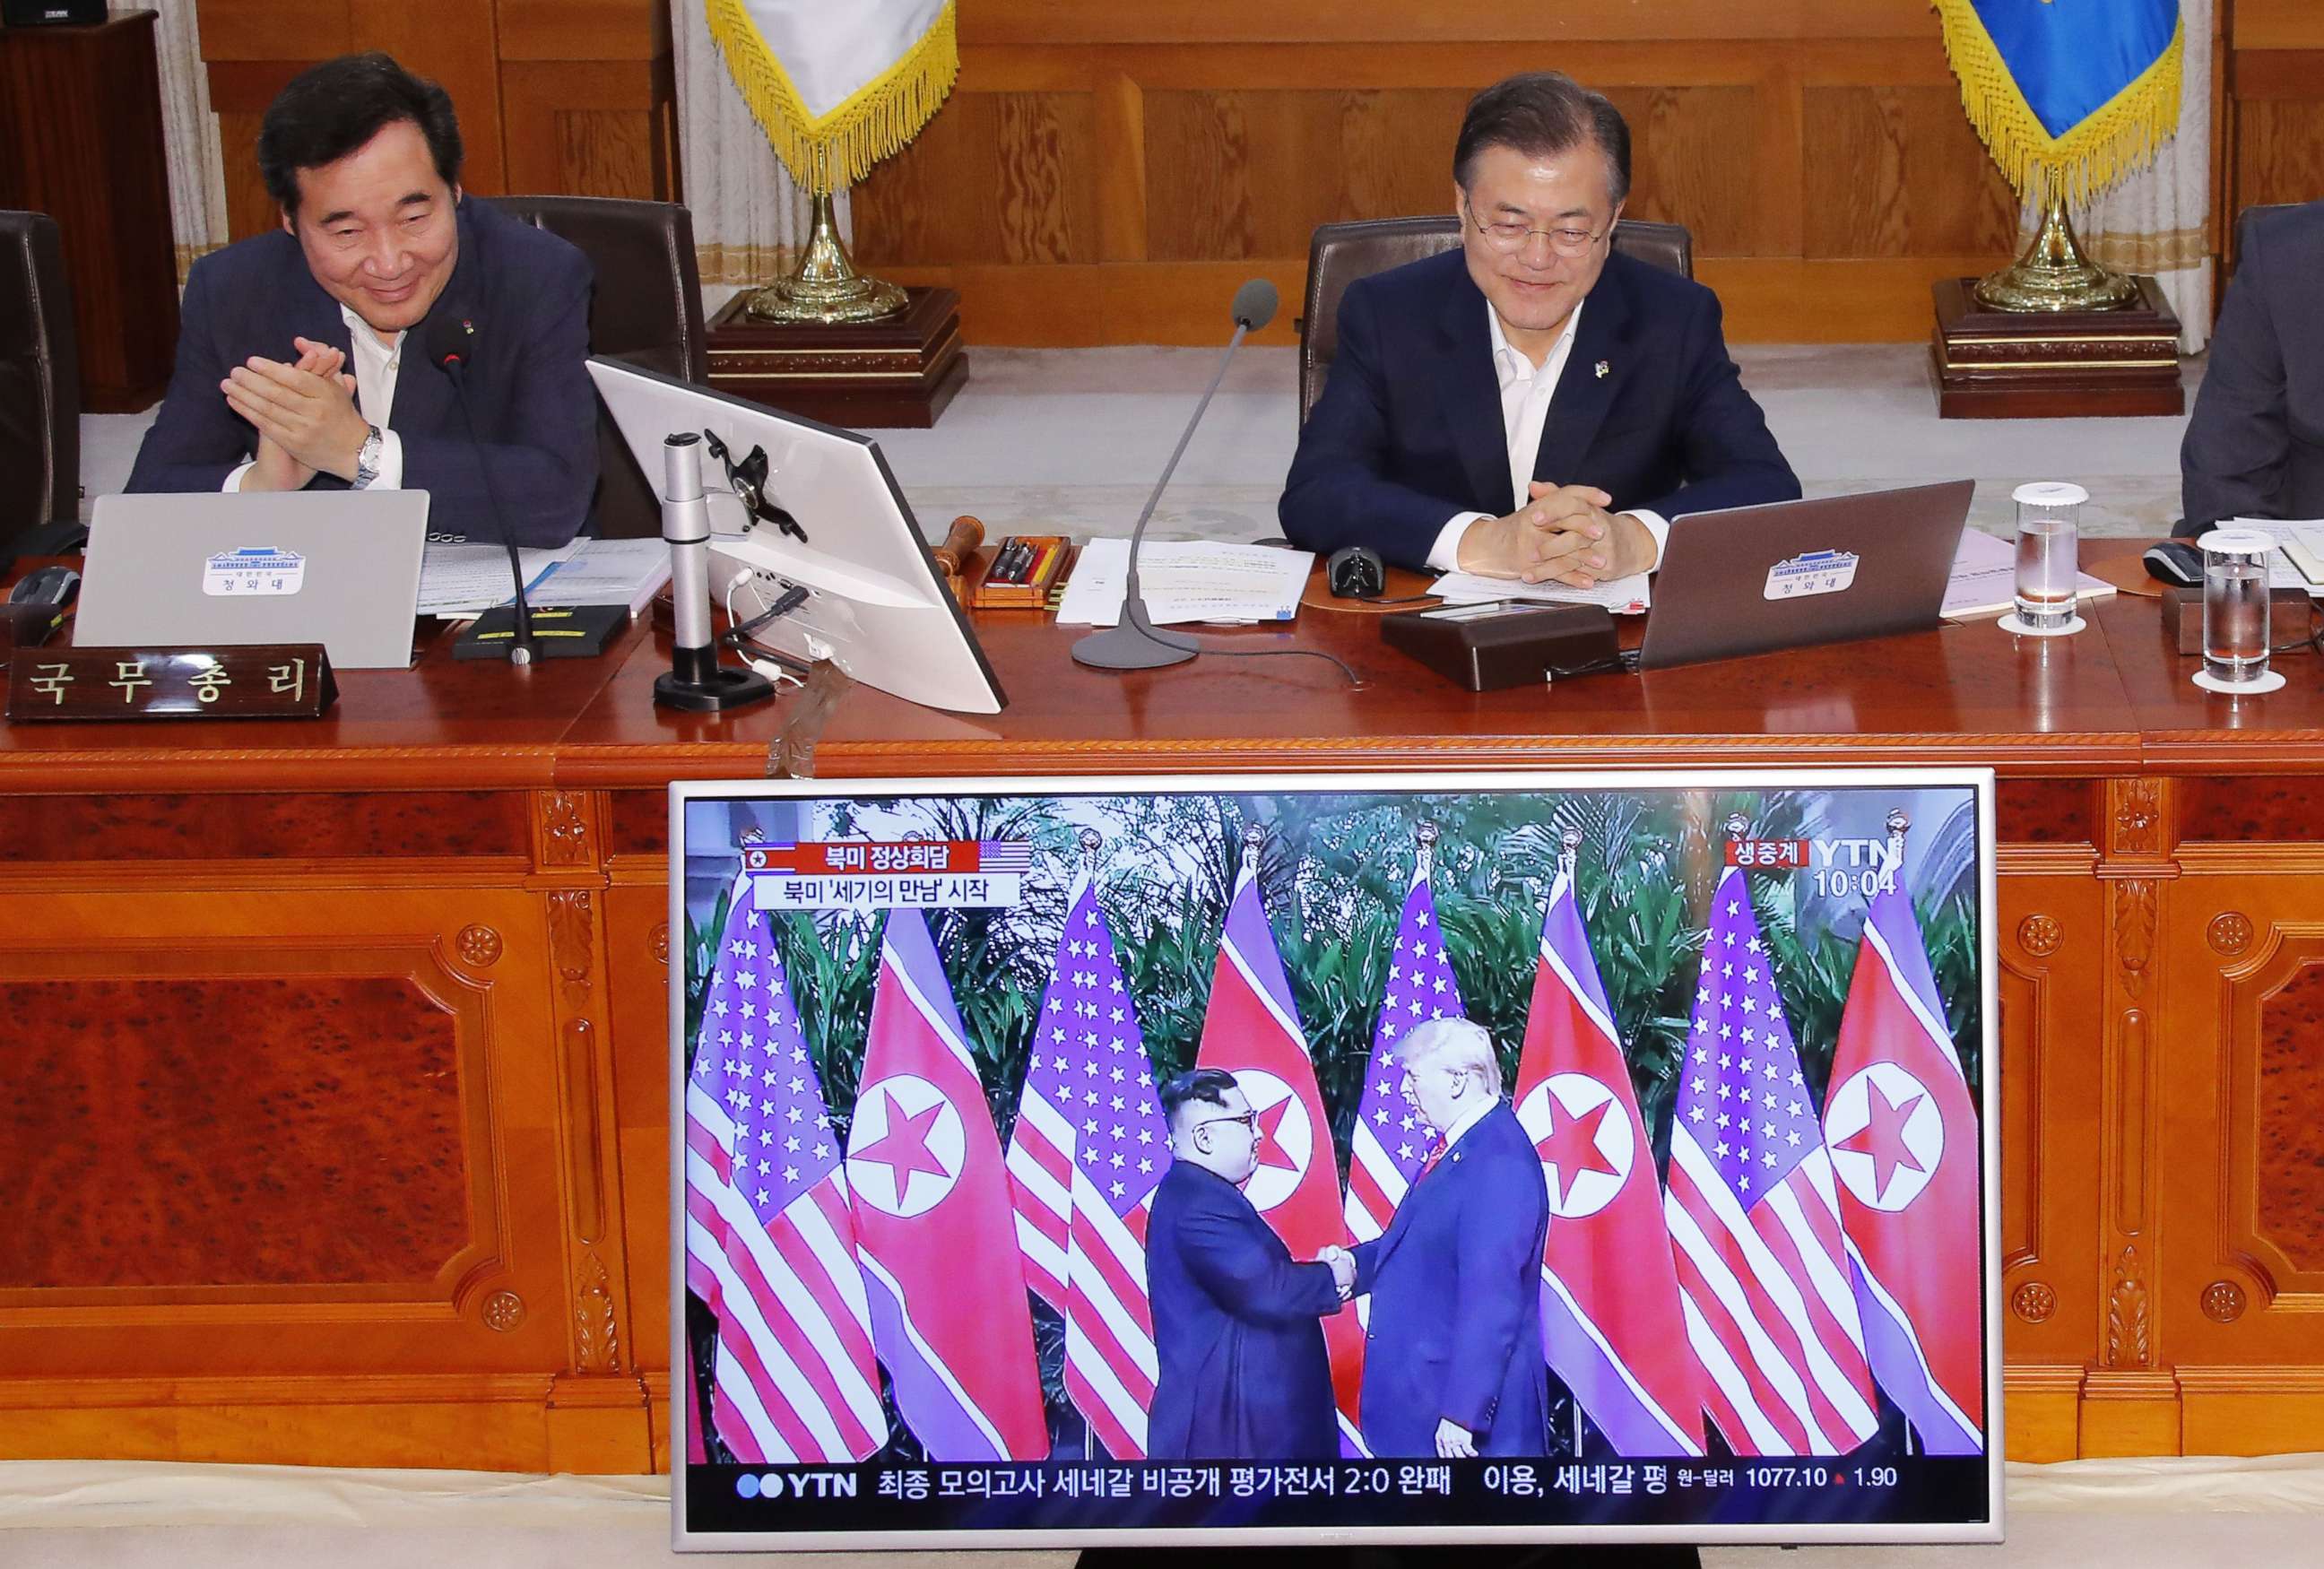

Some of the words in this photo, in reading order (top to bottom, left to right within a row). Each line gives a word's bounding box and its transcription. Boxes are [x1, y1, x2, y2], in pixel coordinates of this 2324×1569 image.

[223, 579, 283, 591] 청와대
[1782, 577, 1836, 594] 청와대
[825, 846, 864, 871] 북미
[871, 845, 950, 871] 정상회담
[1734, 841, 1799, 865] 생중계
[1816, 839, 1898, 867] YTN
[783, 880, 824, 904] 북미
[949, 879, 990, 902] 시작
[1814, 869, 1897, 897] 10:04
[787, 1472, 857, 1498] YTN
[878, 1469, 931, 1500] 최종
[938, 1469, 1046, 1500] 모의고사
[1053, 1468, 1134, 1498] 세네갈
[1143, 1467, 1220, 1497] 비공개
[1229, 1466, 1334, 1497] 평가전서
[1344, 1468, 1390, 1495] 2:0
[1398, 1465, 1451, 1495] 완패
[1484, 1465, 1544, 1498] 이용,
[1553, 1464, 1635, 1495] 세네갈
[1643, 1465, 1668, 1495] 평
[1677, 1469, 1734, 1488] 원-달러
[1746, 1467, 1827, 1487] 1077.10
[1853, 1467, 1898, 1487] 1.90
